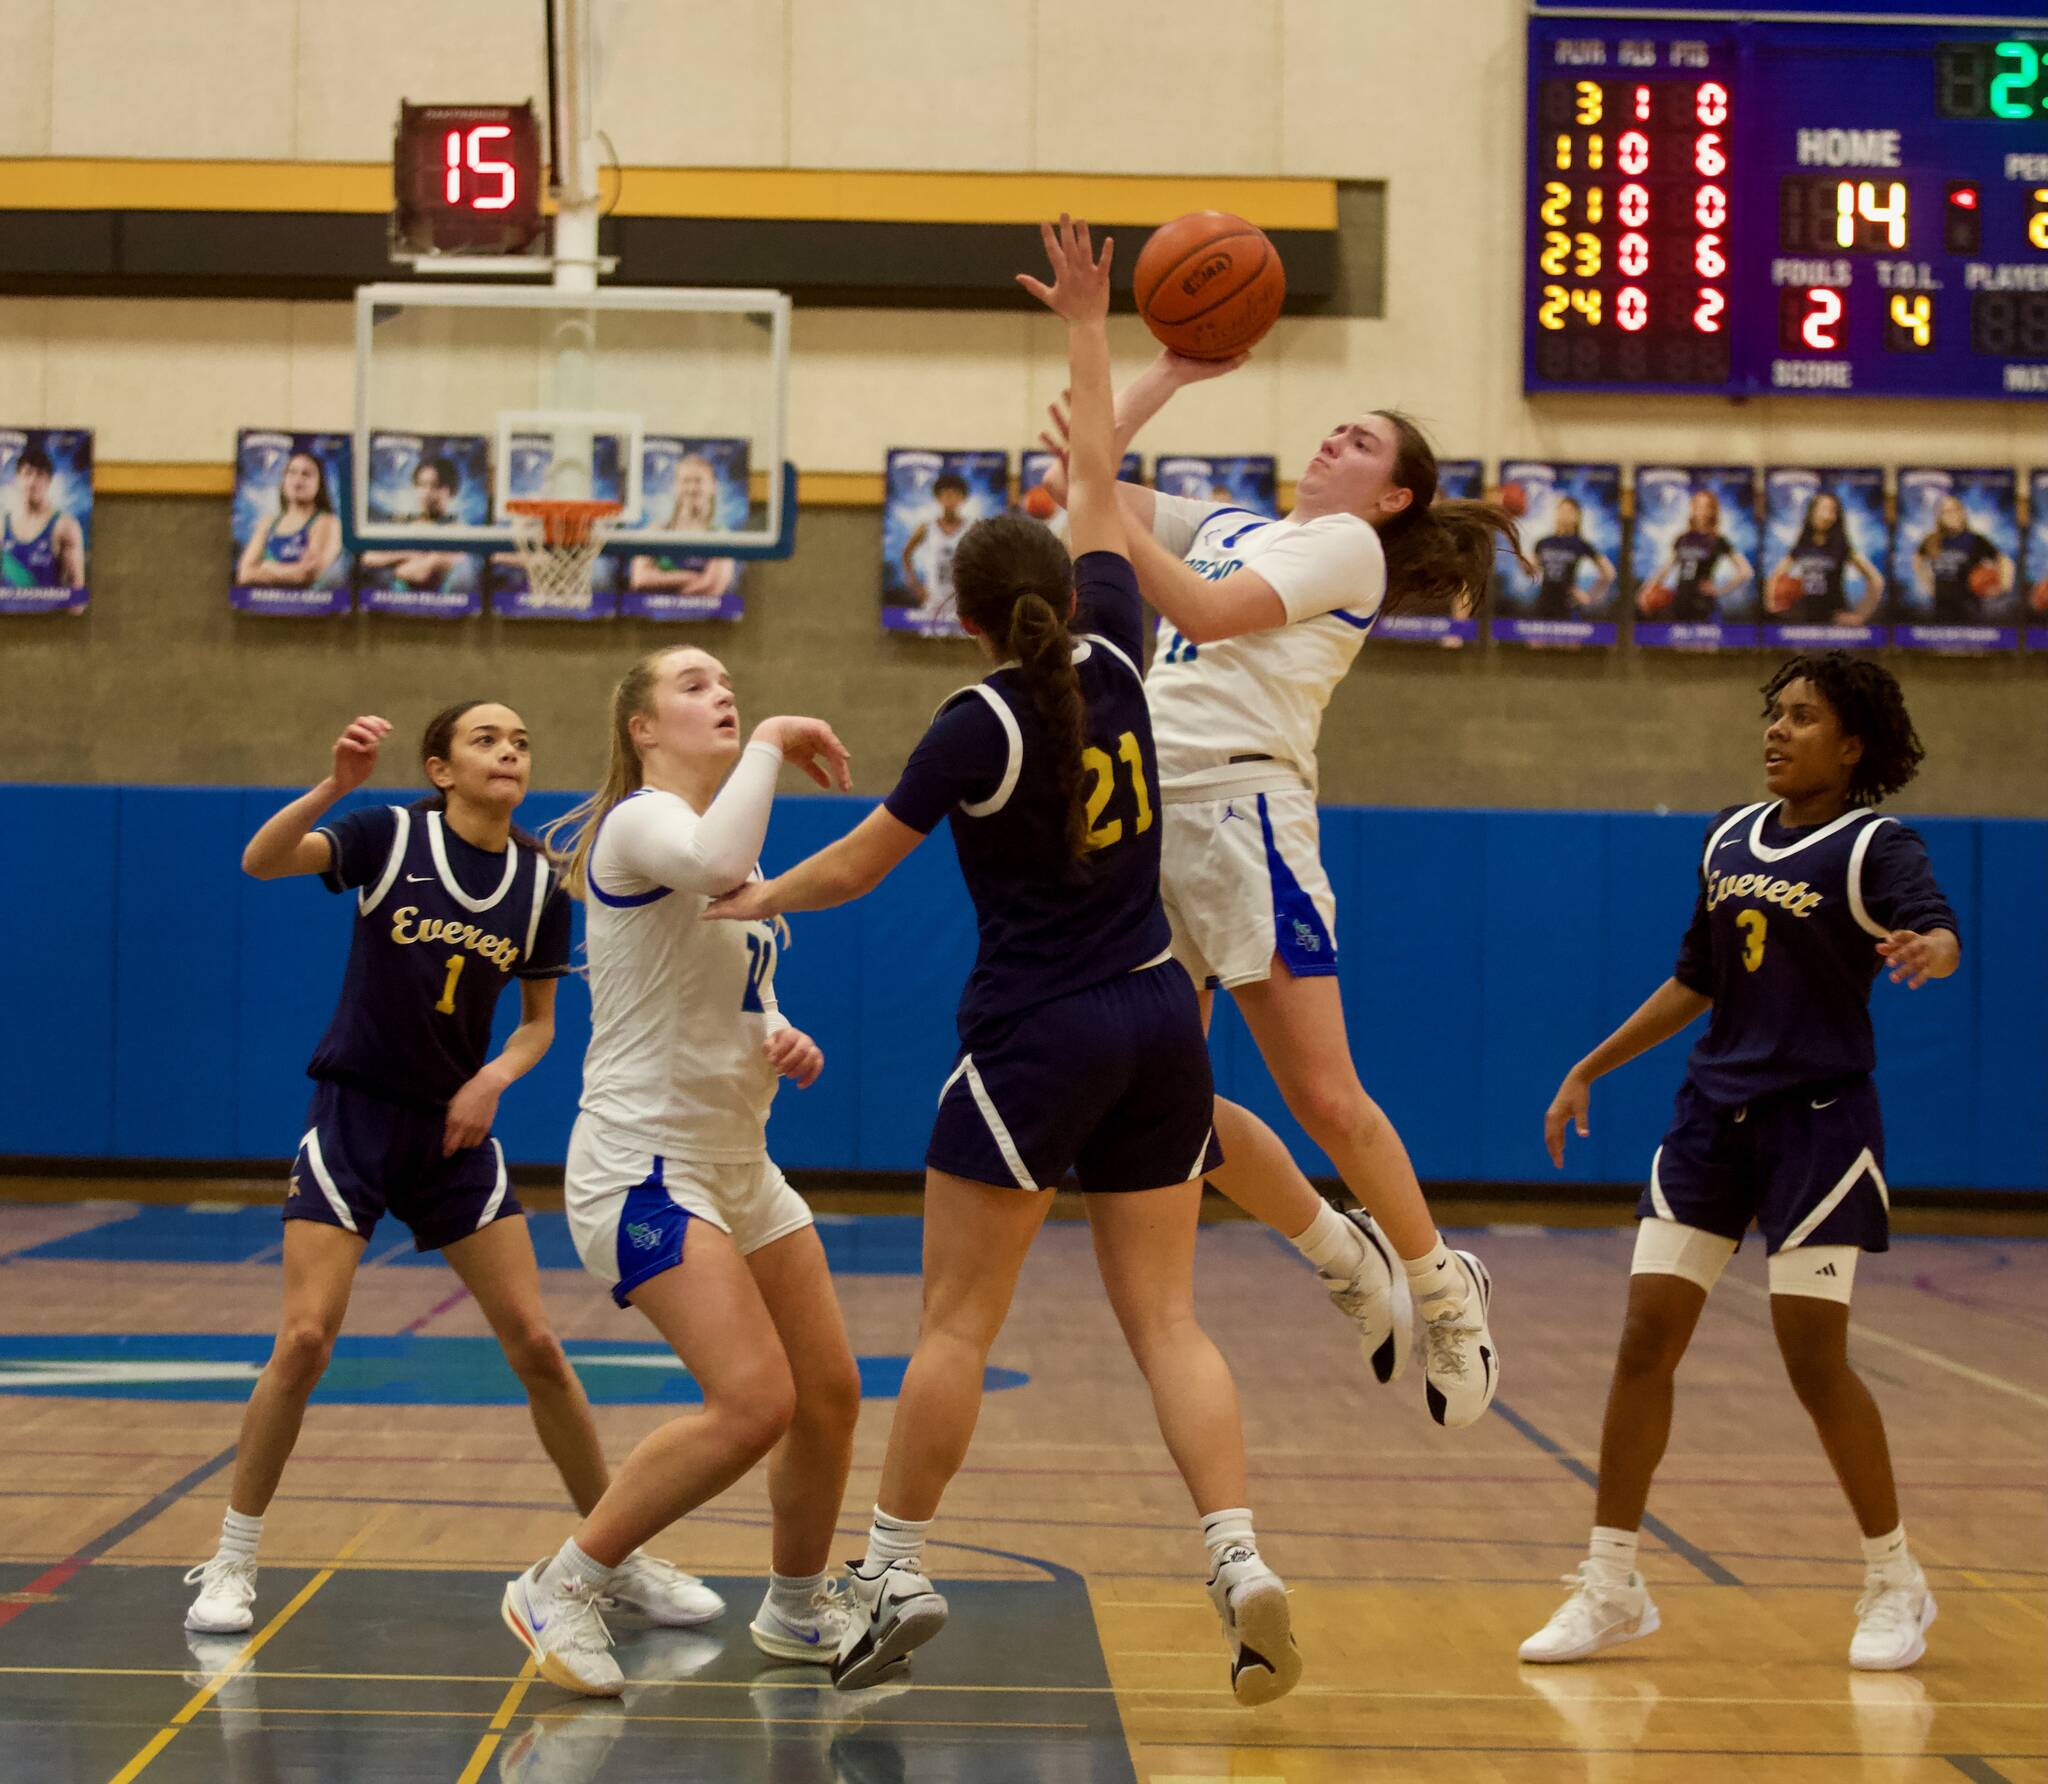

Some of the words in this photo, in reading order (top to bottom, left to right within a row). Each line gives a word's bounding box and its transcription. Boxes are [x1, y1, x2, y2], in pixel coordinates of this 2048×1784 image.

[1575, 80, 1603, 126] 3
[1634, 84, 1650, 124] 1
[1696, 80, 1728, 127] 0
[446, 126, 516, 209] 15
[1556, 133, 1604, 170] 11
[1616, 128, 1649, 176] 0
[1694, 131, 1727, 177] 6
[1796, 127, 1902, 168] HOME
[1540, 181, 1603, 227] 21
[1617, 182, 1649, 228] 0
[1694, 183, 1727, 229] 0
[1836, 180, 1906, 249] 14
[1540, 231, 1602, 278] 23
[1617, 231, 1649, 278] 0
[1695, 232, 1727, 279] 6
[1771, 258, 1853, 288] FOULS
[1538, 284, 1602, 330] 24
[1615, 285, 1648, 332] 0
[1693, 286, 1725, 333] 2
[1802, 287, 1843, 349] 2
[1890, 293, 1931, 347] 4
[1771, 358, 1853, 388] SCORE
[1082, 731, 1153, 852] 21
[1706, 869, 1825, 918] Everett
[391, 905, 520, 972] Everett
[1735, 908, 1768, 973] 3
[434, 953, 465, 1015] 1
